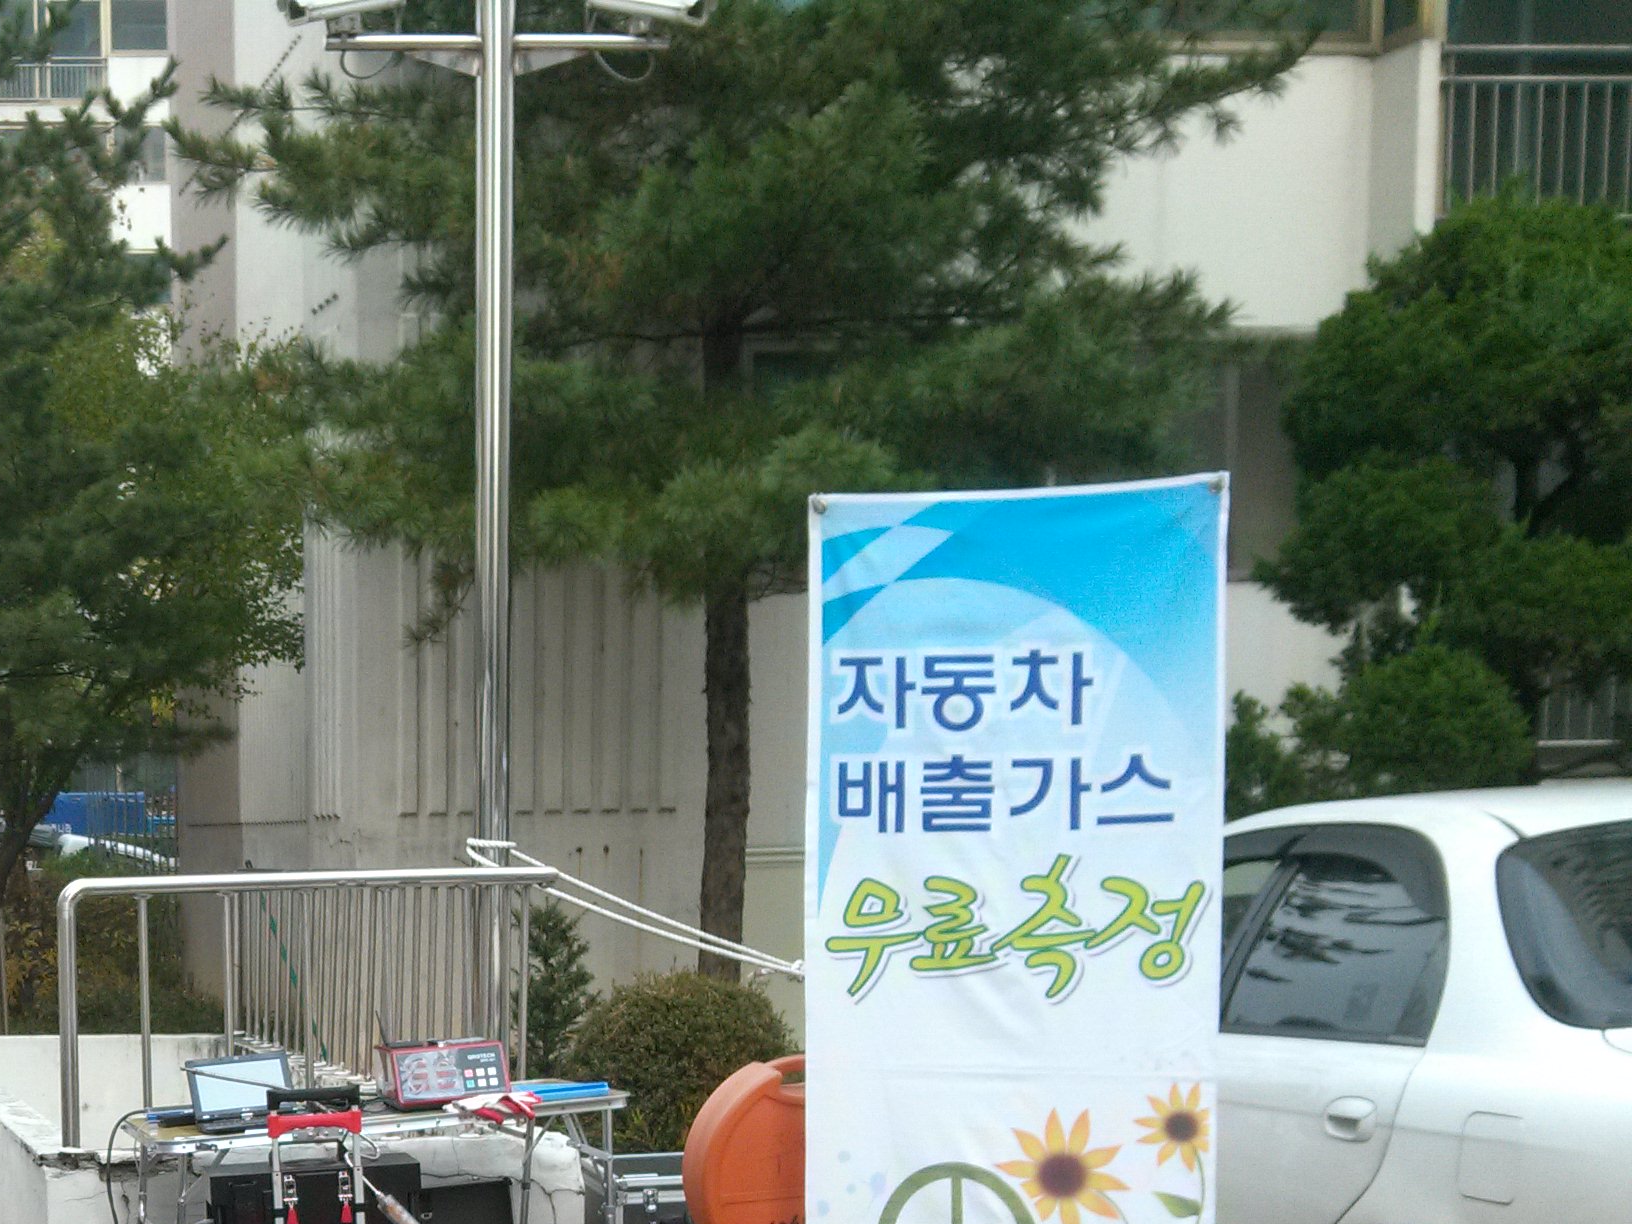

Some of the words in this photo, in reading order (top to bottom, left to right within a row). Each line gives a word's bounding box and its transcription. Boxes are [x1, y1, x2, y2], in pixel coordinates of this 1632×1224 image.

[836, 648, 1093, 731] 자동차
[836, 753, 1175, 833] 배출가스
[825, 853, 1206, 998] 무료측정
